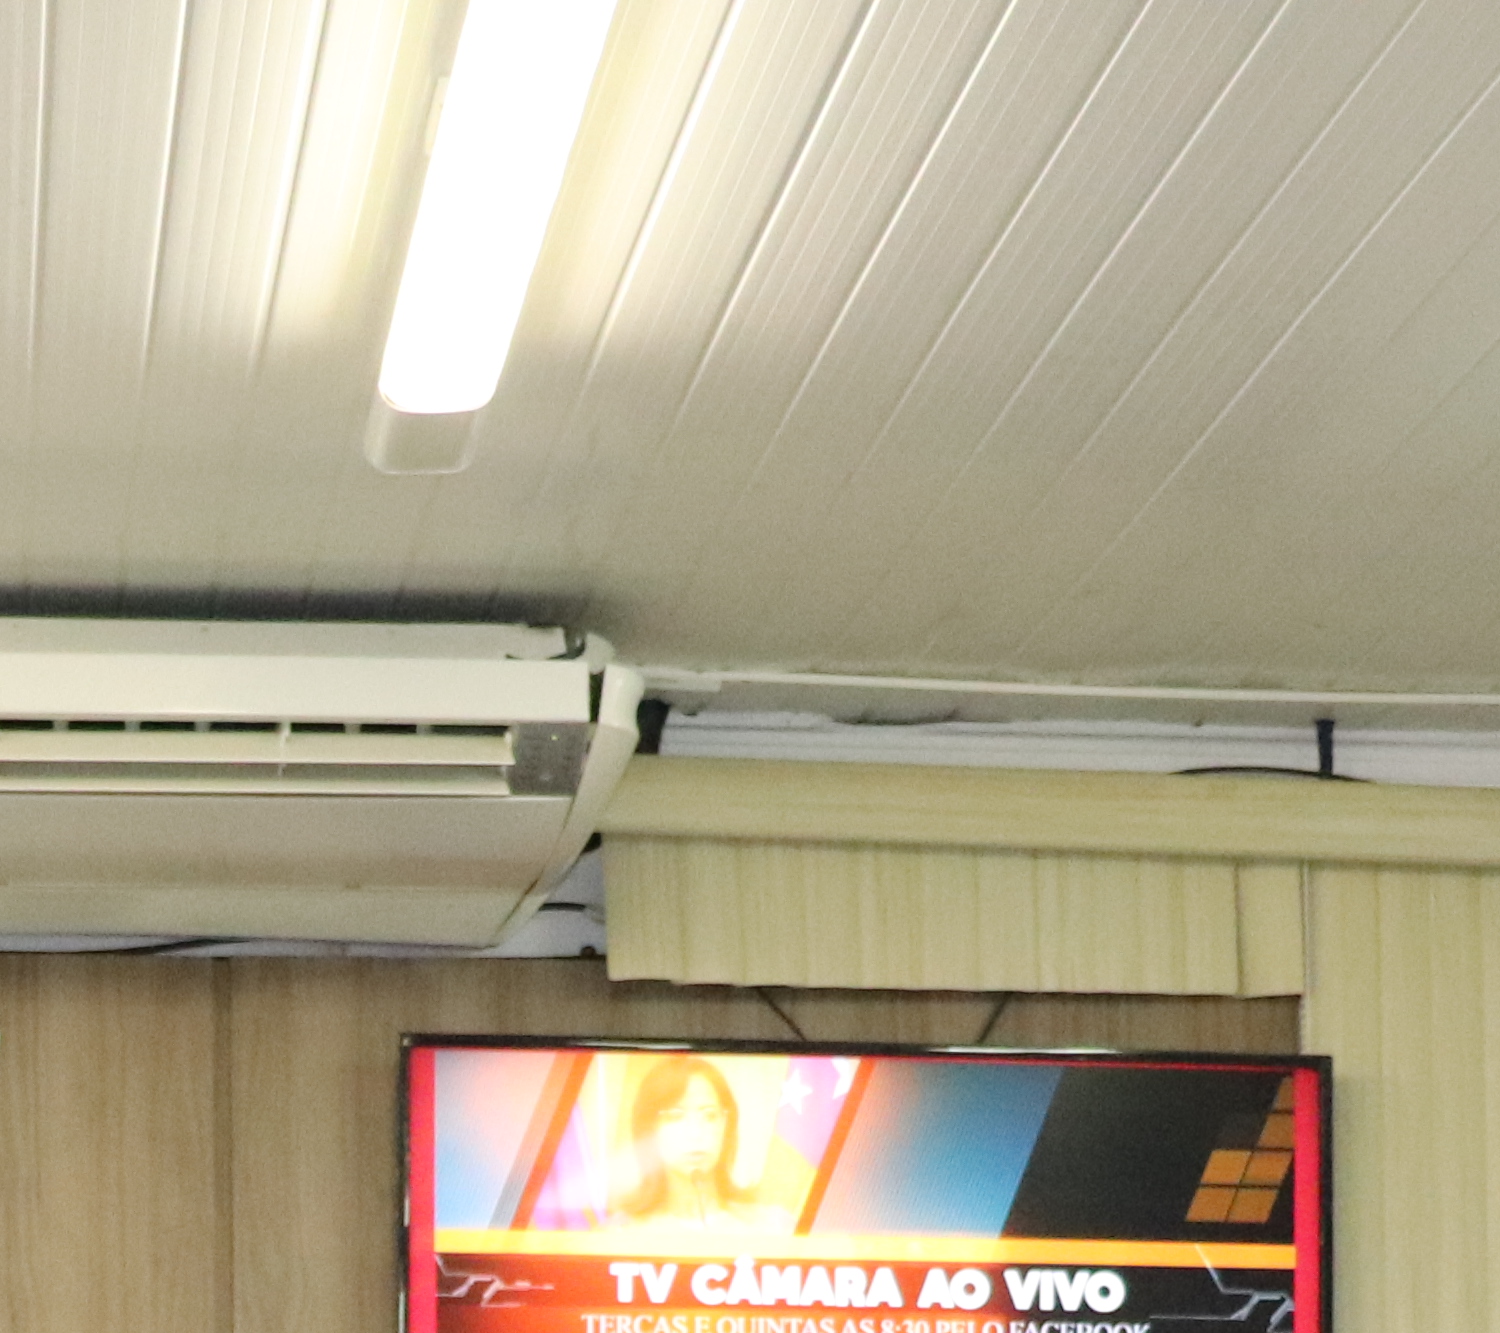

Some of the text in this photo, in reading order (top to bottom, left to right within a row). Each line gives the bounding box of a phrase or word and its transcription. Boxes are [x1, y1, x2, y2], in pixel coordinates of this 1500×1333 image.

[608, 1253, 1126, 1314] TV CÂMARA AO VIVO
